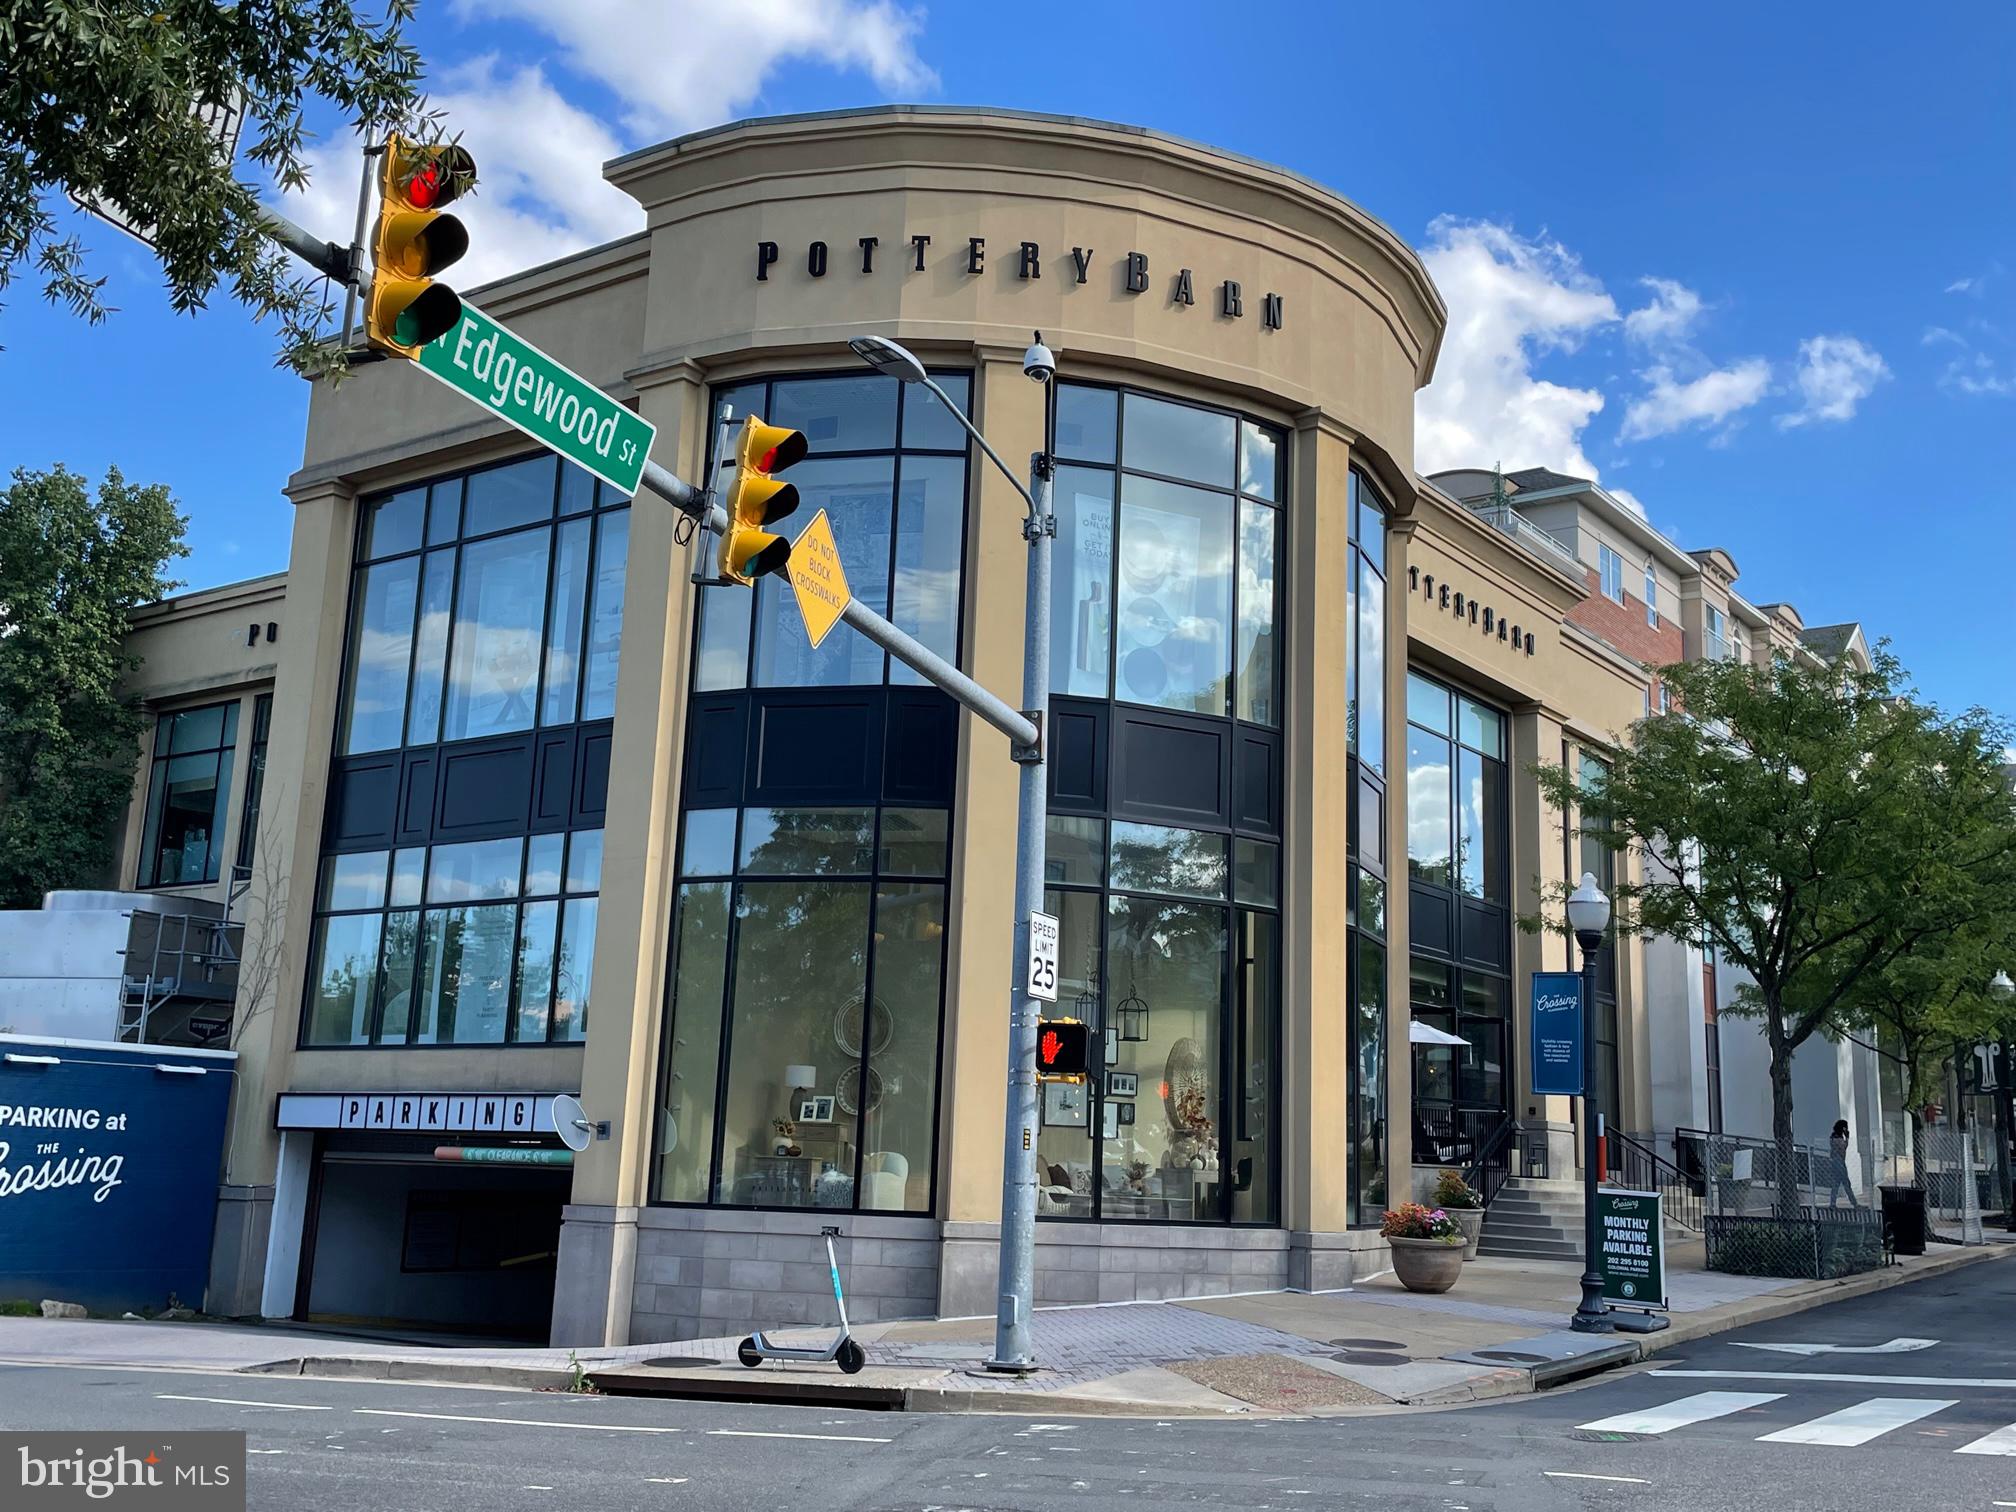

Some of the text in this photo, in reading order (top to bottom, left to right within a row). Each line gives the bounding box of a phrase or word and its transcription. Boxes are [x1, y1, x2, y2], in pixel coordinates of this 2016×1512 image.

[452, 316, 620, 458] Edgewood
[807, 534, 834, 563] DO NOT
[808, 557, 831, 582] BLOCK
[795, 570, 841, 610] CROSSWALKS
[1032, 921, 1057, 940] SPEED
[1034, 937, 1054, 954] LIMIT
[1032, 956, 1055, 990] 25
[1536, 994, 1578, 1011] Crossing
[0, 1105, 127, 1131] PARKING at
[349, 1100, 525, 1126] PARKING
[37, 1142, 60, 1154] THE
[1603, 1215, 1650, 1230] MONTHLY
[1607, 1229, 1648, 1243] PARKING
[1603, 1241, 1653, 1256] AVAILABLE
[1607, 1256, 1619, 1264] 202
